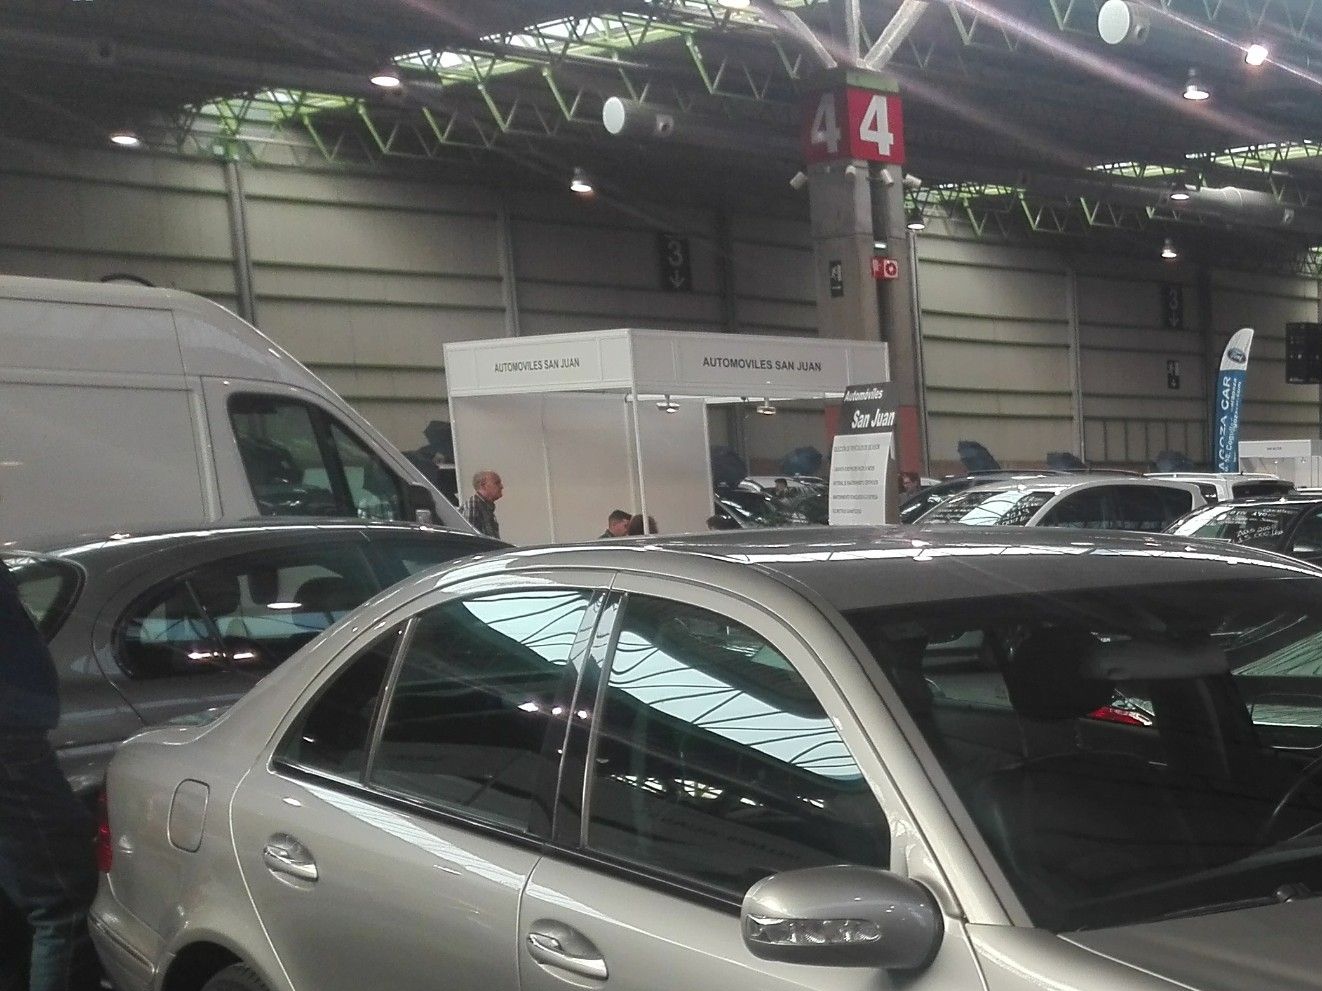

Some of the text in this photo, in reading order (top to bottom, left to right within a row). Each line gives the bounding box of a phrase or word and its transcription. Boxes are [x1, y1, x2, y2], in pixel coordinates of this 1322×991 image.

[811, 92, 841, 154] 4
[859, 94, 894, 156] 4
[667, 240, 683, 266] 3
[494, 357, 580, 373] AUTOMOVILES SAN JUAN
[702, 357, 822, 372] AUTOMOVILES SAN JUAN
[1220, 376, 1231, 411] CAR
[851, 408, 896, 429] San Juan
